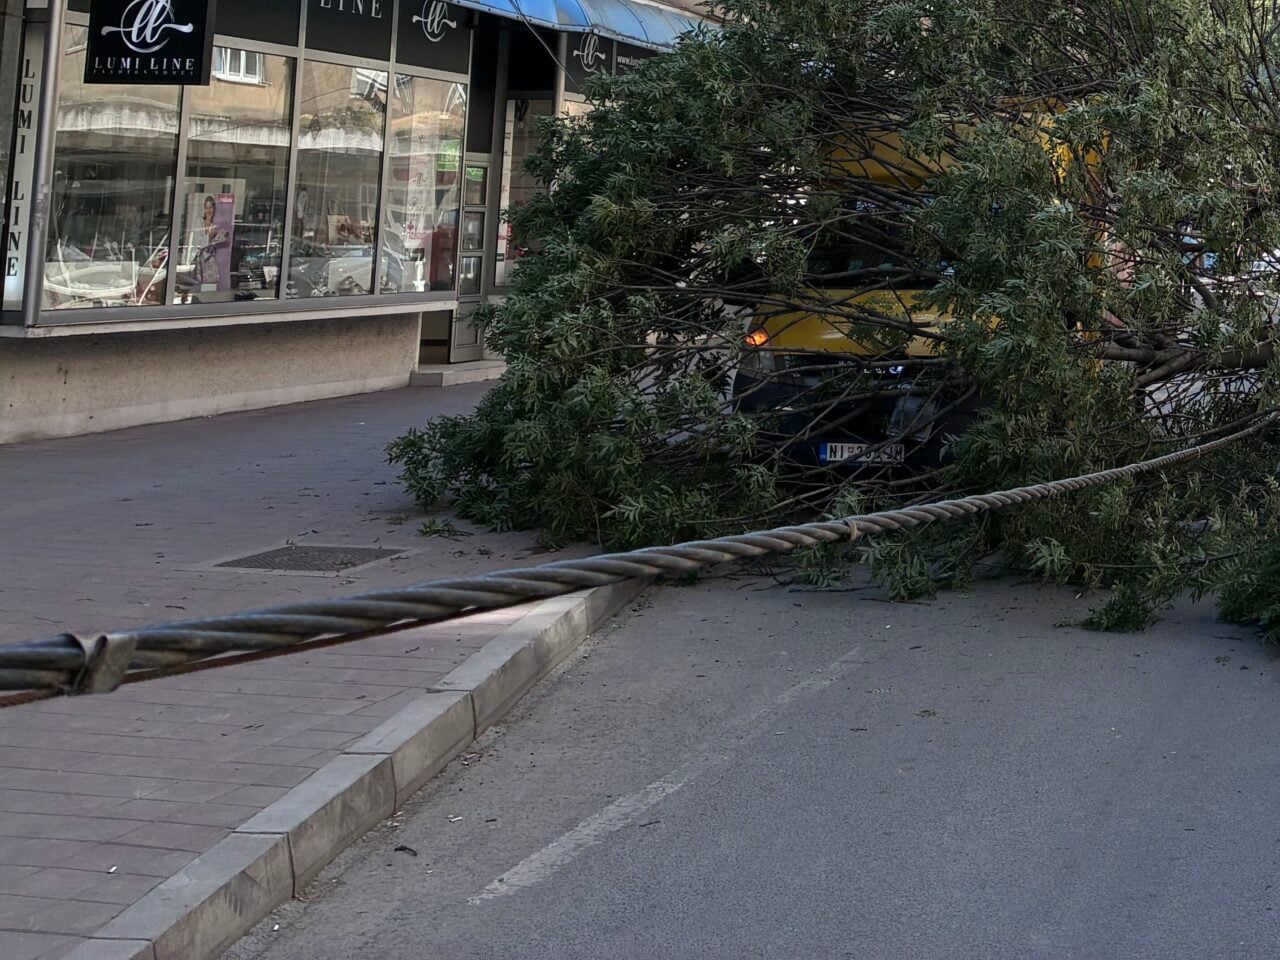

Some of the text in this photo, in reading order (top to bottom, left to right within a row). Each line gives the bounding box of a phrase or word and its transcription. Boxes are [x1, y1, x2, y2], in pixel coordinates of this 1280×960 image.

[95, 56, 195, 71] LUMI LINE
[5, 58, 36, 278] LUMI LINE
[829, 444, 844, 459] NI
